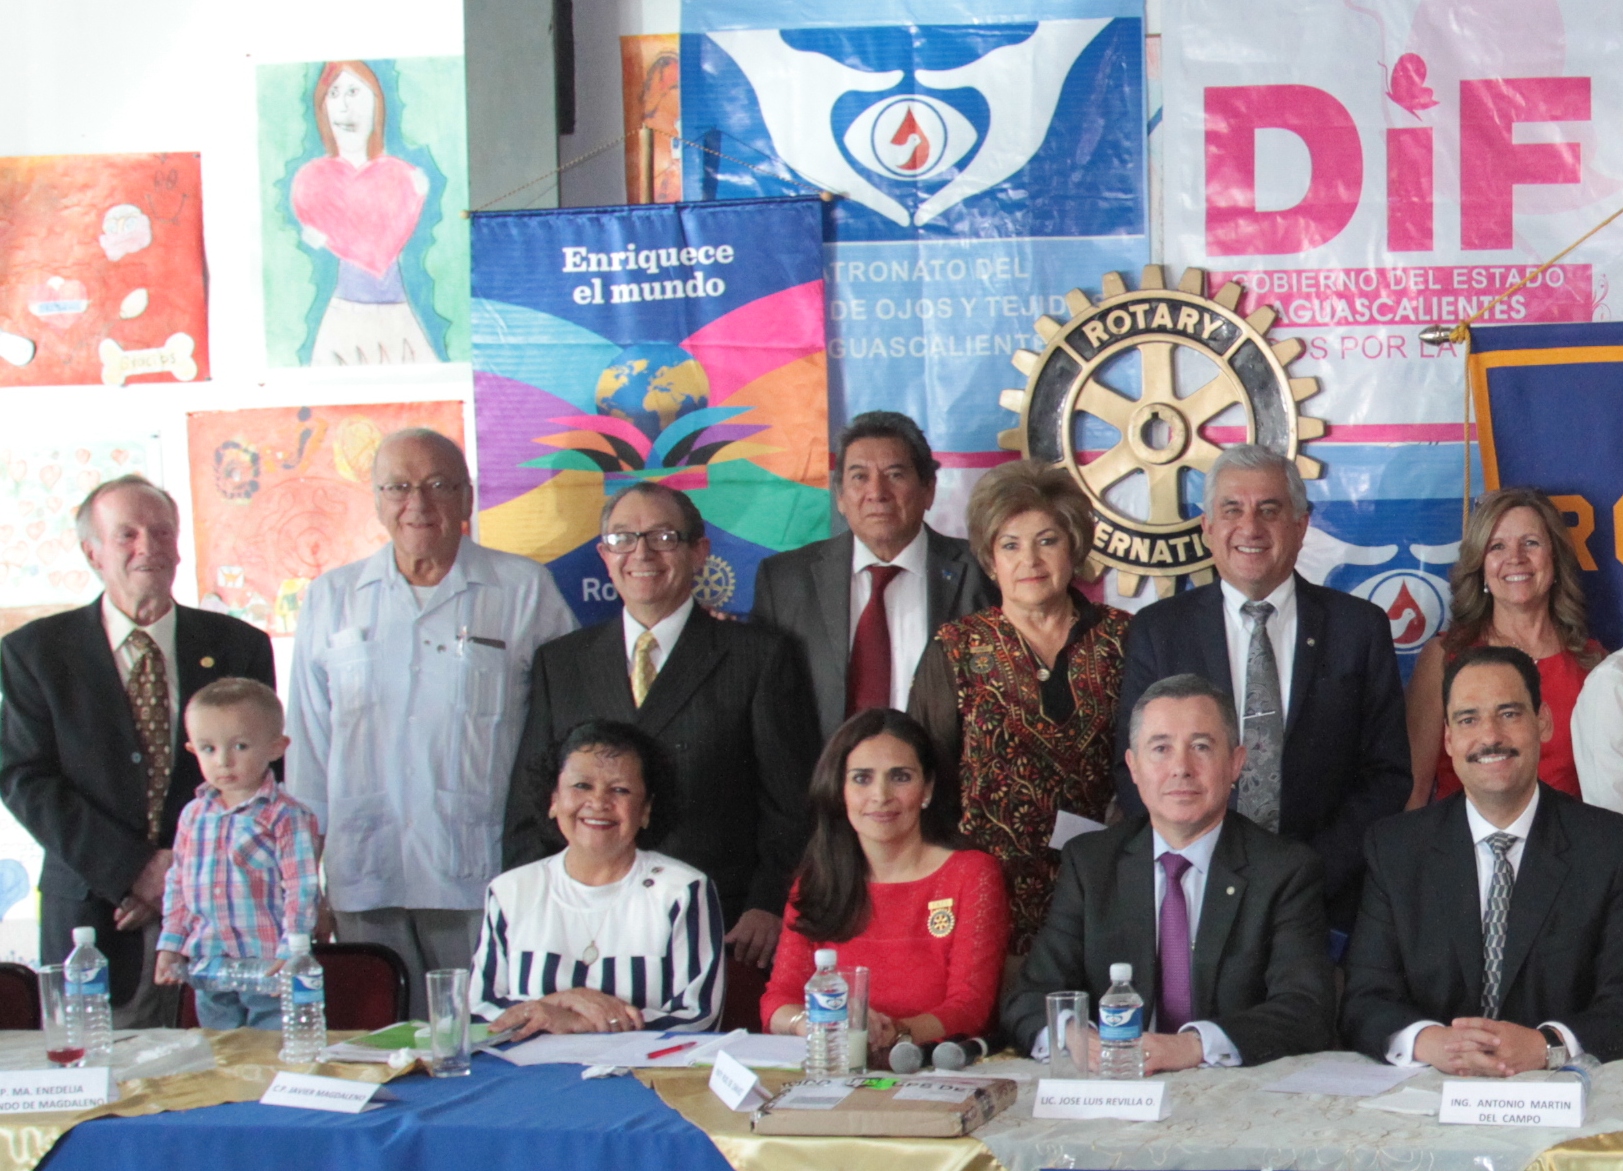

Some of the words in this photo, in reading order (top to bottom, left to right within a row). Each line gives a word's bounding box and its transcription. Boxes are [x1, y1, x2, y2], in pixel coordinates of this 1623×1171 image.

[1204, 76, 1592, 257] DiF
[562, 243, 734, 274] Enriquece
[976, 257, 1029, 279] DEL
[573, 278, 605, 305] el
[610, 271, 726, 304] mundo
[1390, 270, 1441, 290] DEL
[1454, 267, 1564, 289] ESTADO
[830, 299, 867, 321] DE
[875, 298, 953, 321] OJOS
[960, 297, 977, 319] Y
[1273, 296, 1526, 323] AGUASCALIENTES
[1082, 302, 1226, 349] ROTARY
[1341, 335, 1407, 360] POR
[12, 1087, 33, 1097] MA.
[36, 1085, 84, 1096] ENEDELIA
[288, 1086, 315, 1097] JAVIER
[315, 1089, 366, 1101] MAGDALENO
[1040, 1096, 1056, 1105] LIC.
[1059, 1097, 1080, 1106] JOSE
[1083, 1097, 1103, 1106] LUIS
[1105, 1098, 1142, 1106] REVILLA
[22, 1101, 36, 1110] DE
[38, 1098, 105, 1110] MAGDALENO
[1451, 1098, 1471, 1107] ING.
[1477, 1099, 1525, 1109] ANTONIO
[1530, 1100, 1571, 1110] MARTIN
[1479, 1113, 1497, 1123] DEL
[1502, 1114, 1541, 1124] CAMPO
